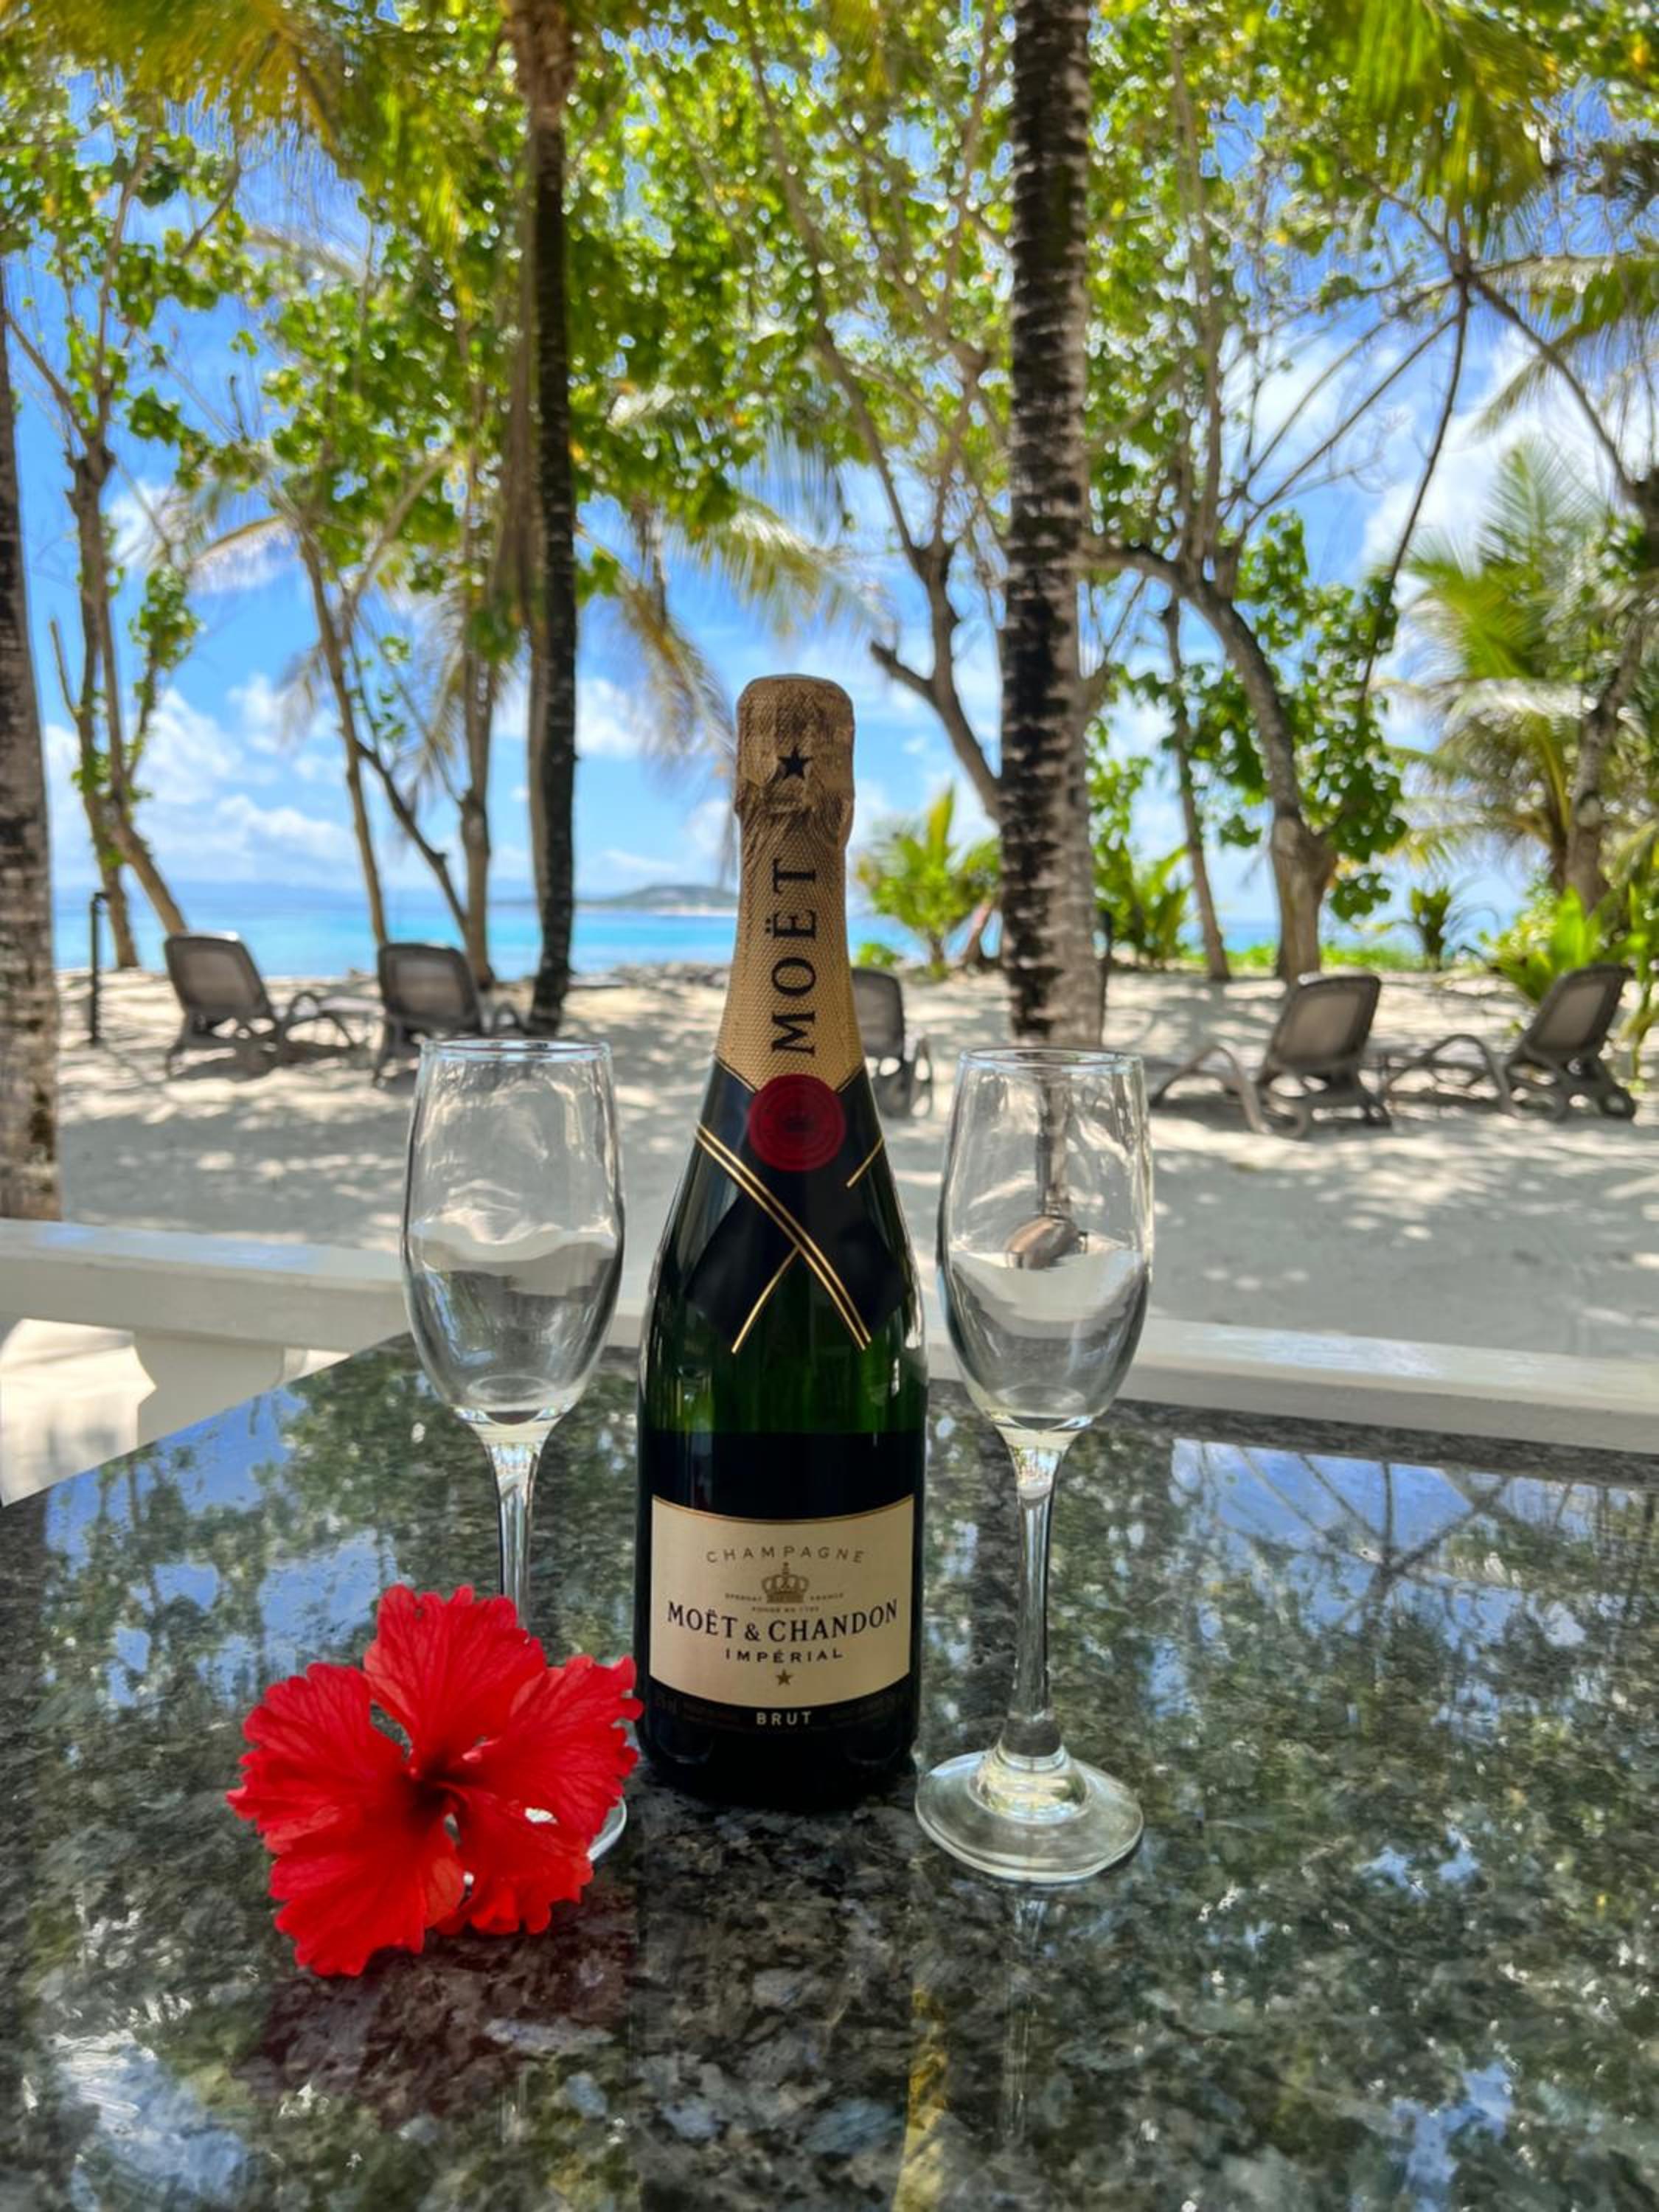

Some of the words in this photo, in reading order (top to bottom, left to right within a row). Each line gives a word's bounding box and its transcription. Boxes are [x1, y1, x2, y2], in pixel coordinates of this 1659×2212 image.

[765, 857, 817, 1056] MOËT
[706, 1545, 865, 1563] CHAMPAGNE
[667, 1601, 737, 1638] MOËT
[744, 1623, 761, 1641] &
[768, 1599, 897, 1642] CHANDON
[726, 1648, 843, 1663] IMPÉRIAL
[756, 1711, 812, 1725] BRUT
